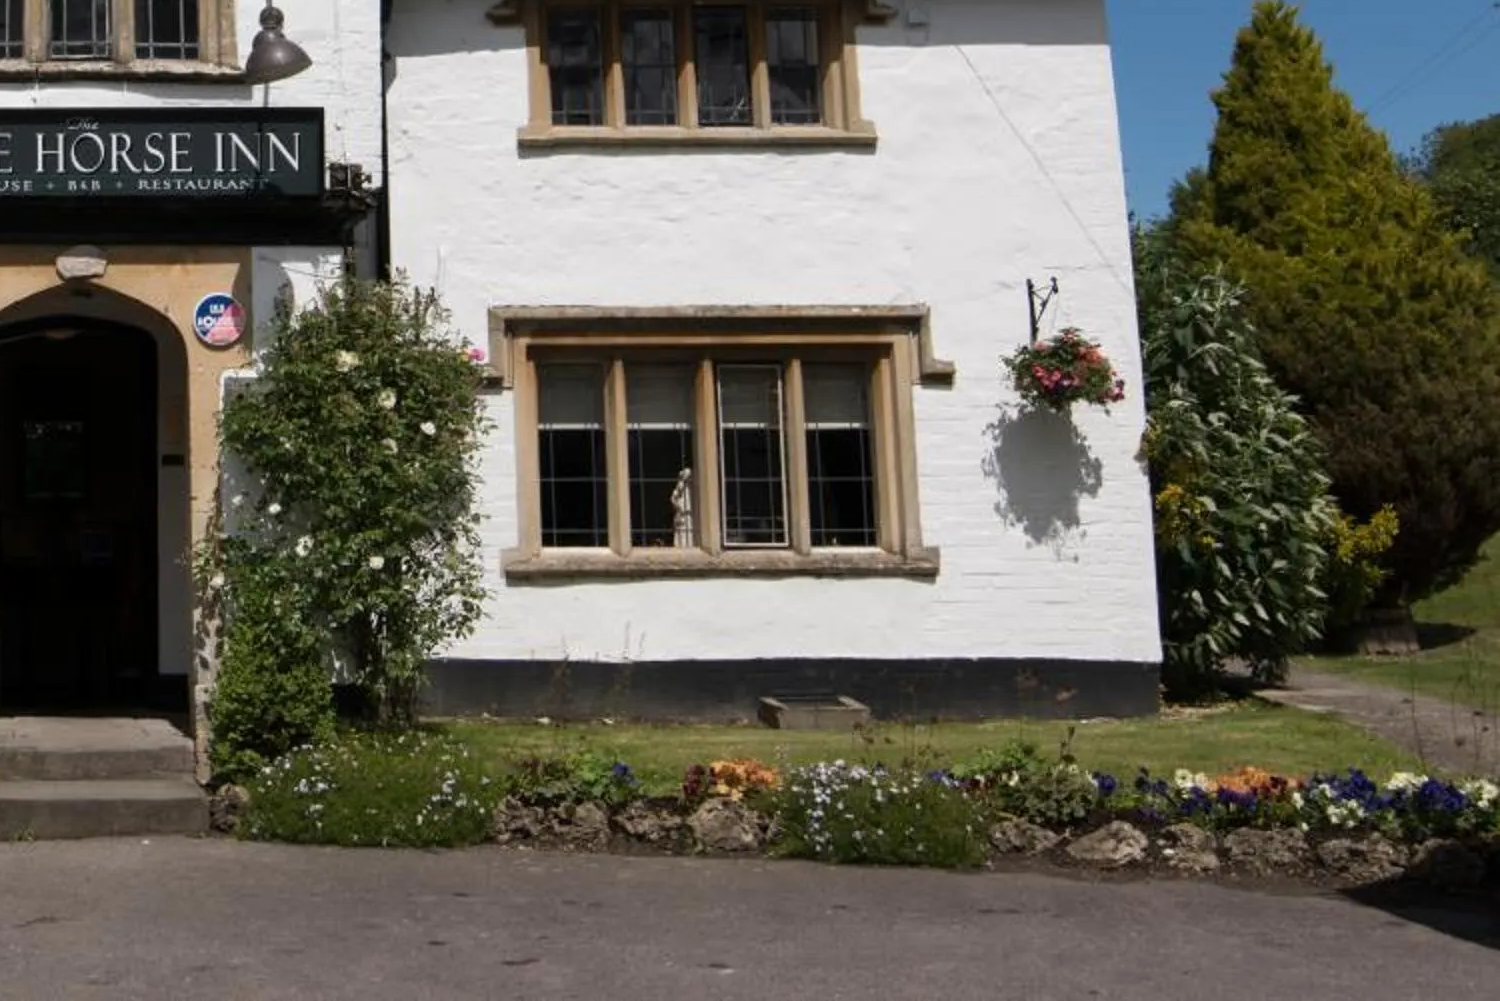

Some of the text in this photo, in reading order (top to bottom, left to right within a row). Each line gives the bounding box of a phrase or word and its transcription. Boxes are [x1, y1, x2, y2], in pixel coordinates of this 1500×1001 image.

[36, 132, 194, 174] HORSE
[214, 132, 301, 173] INN
[138, 178, 269, 190] RESTAURANT
